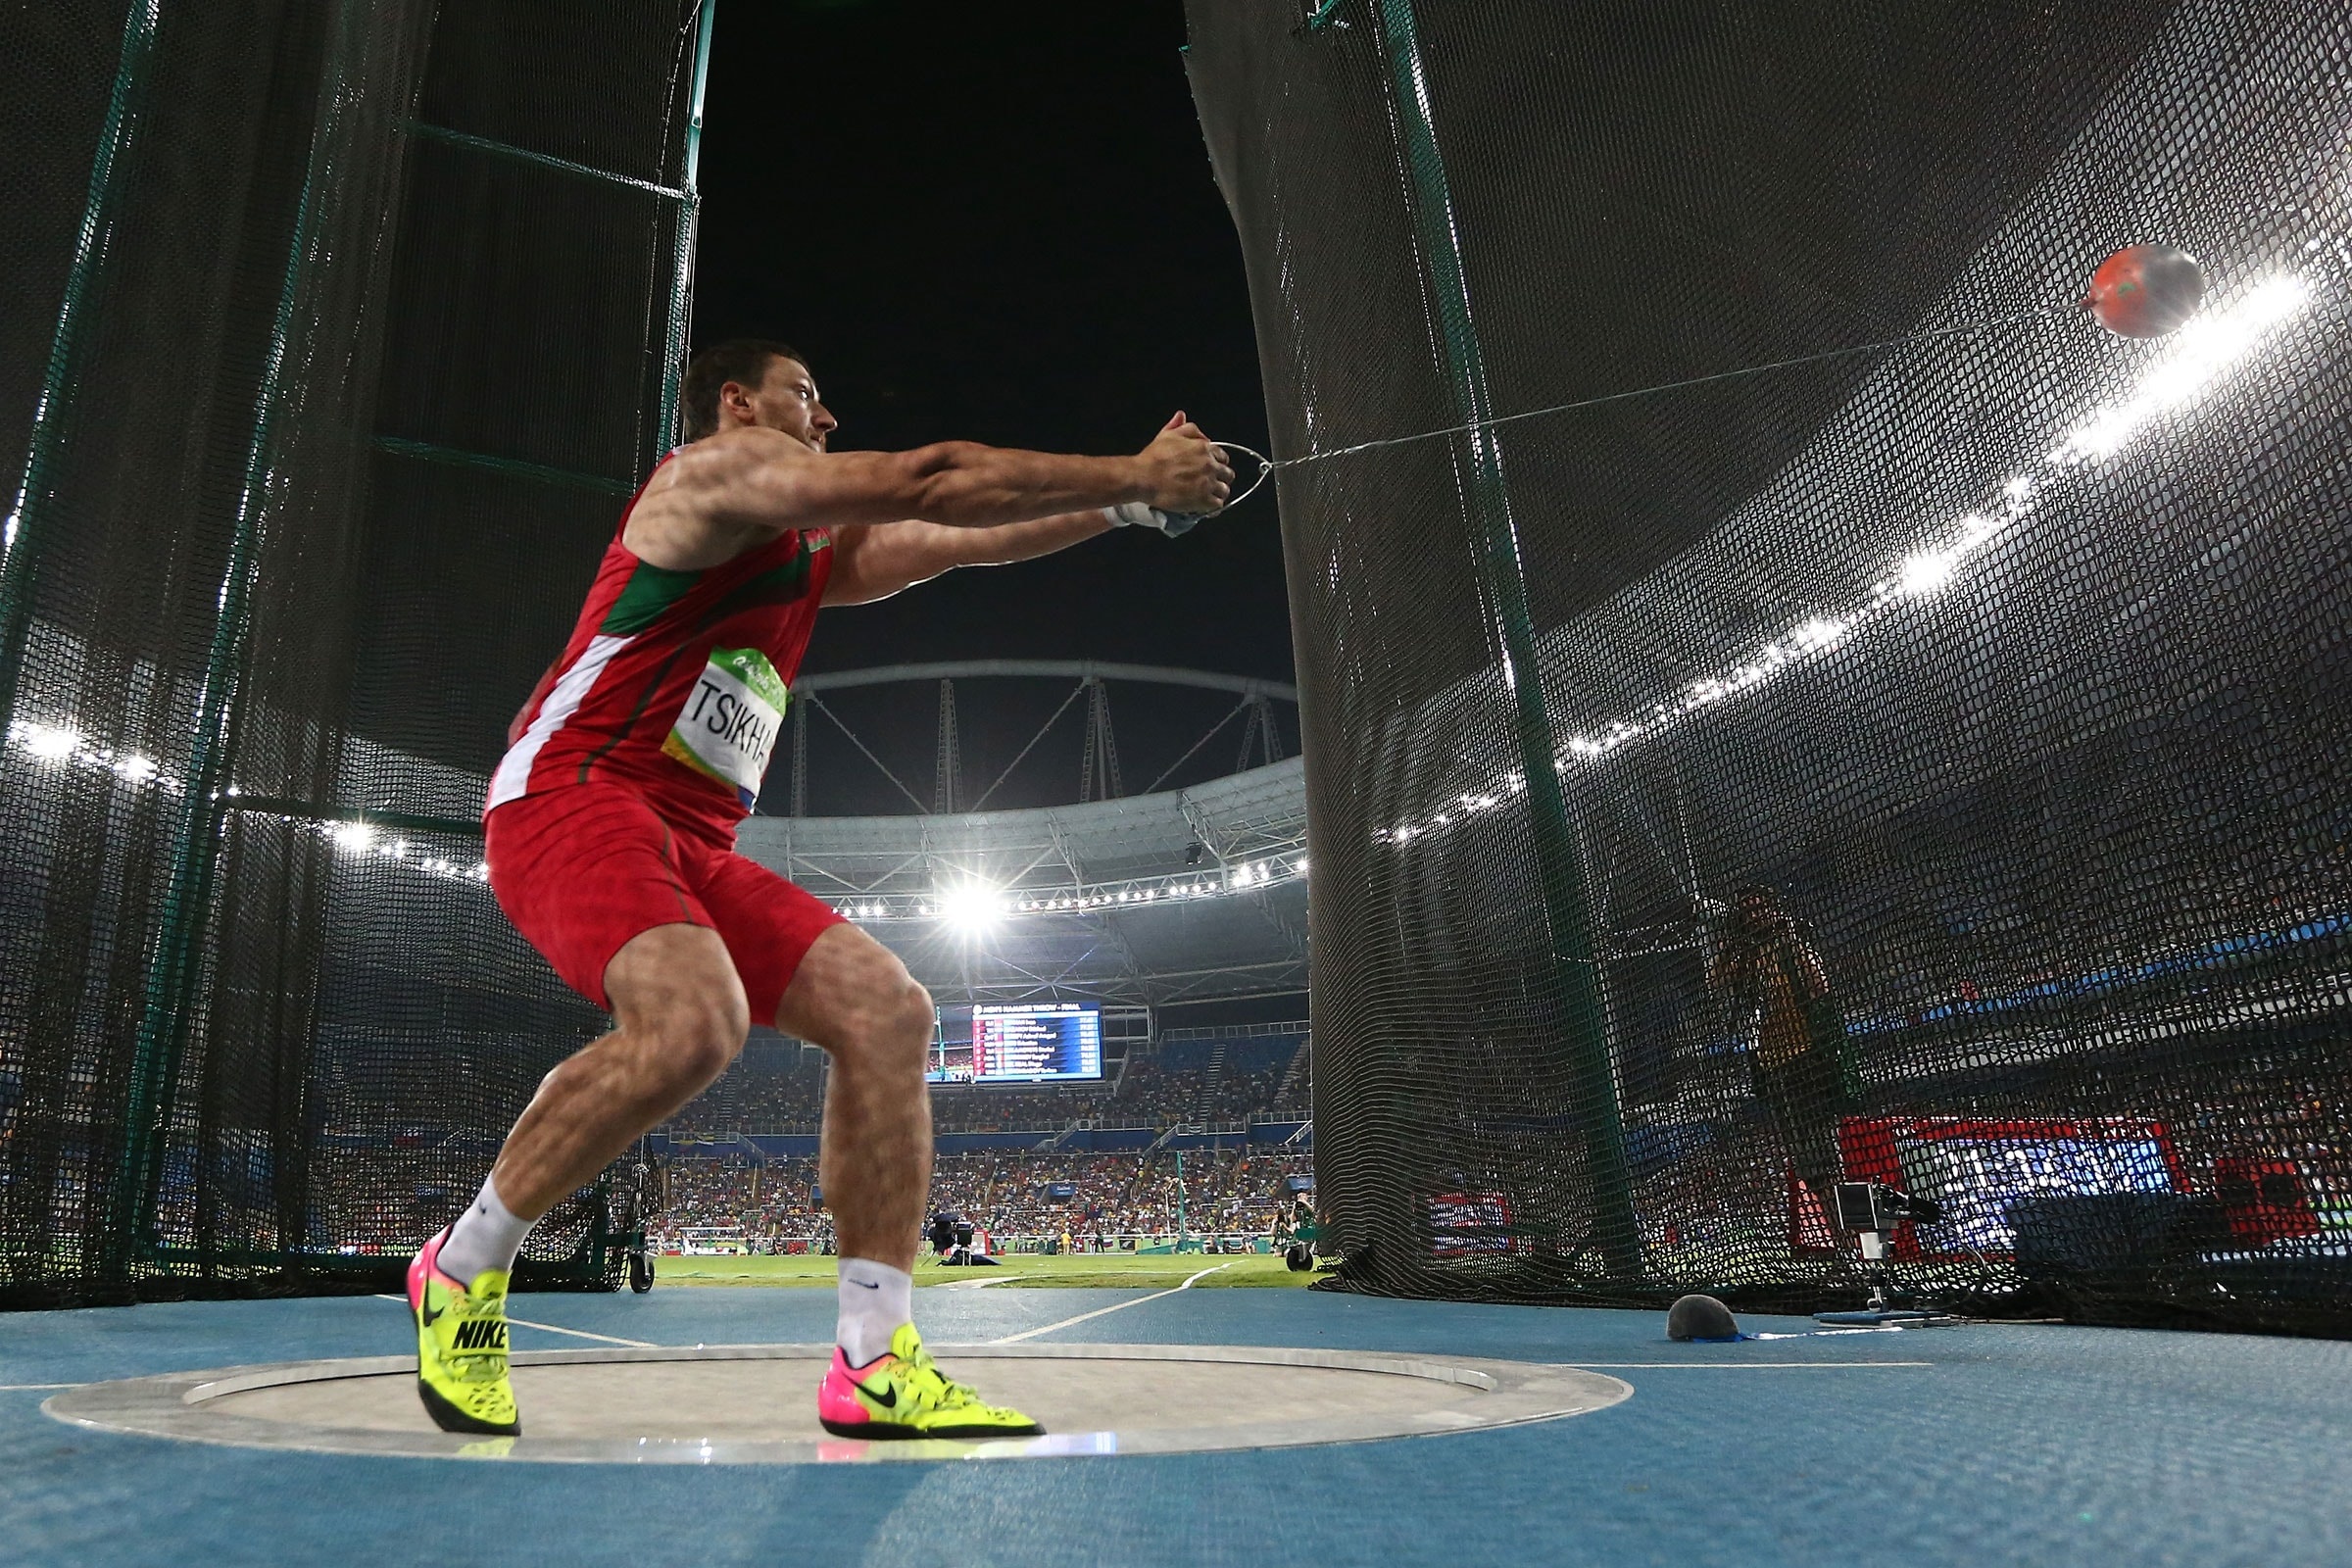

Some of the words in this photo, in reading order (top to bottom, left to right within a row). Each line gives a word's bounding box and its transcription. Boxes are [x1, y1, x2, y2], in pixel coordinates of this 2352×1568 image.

[1003, 1004, 1032, 1013] HAMMER
[1033, 1004, 1056, 1012] THROW
[452, 1319, 508, 1349] NIKE
